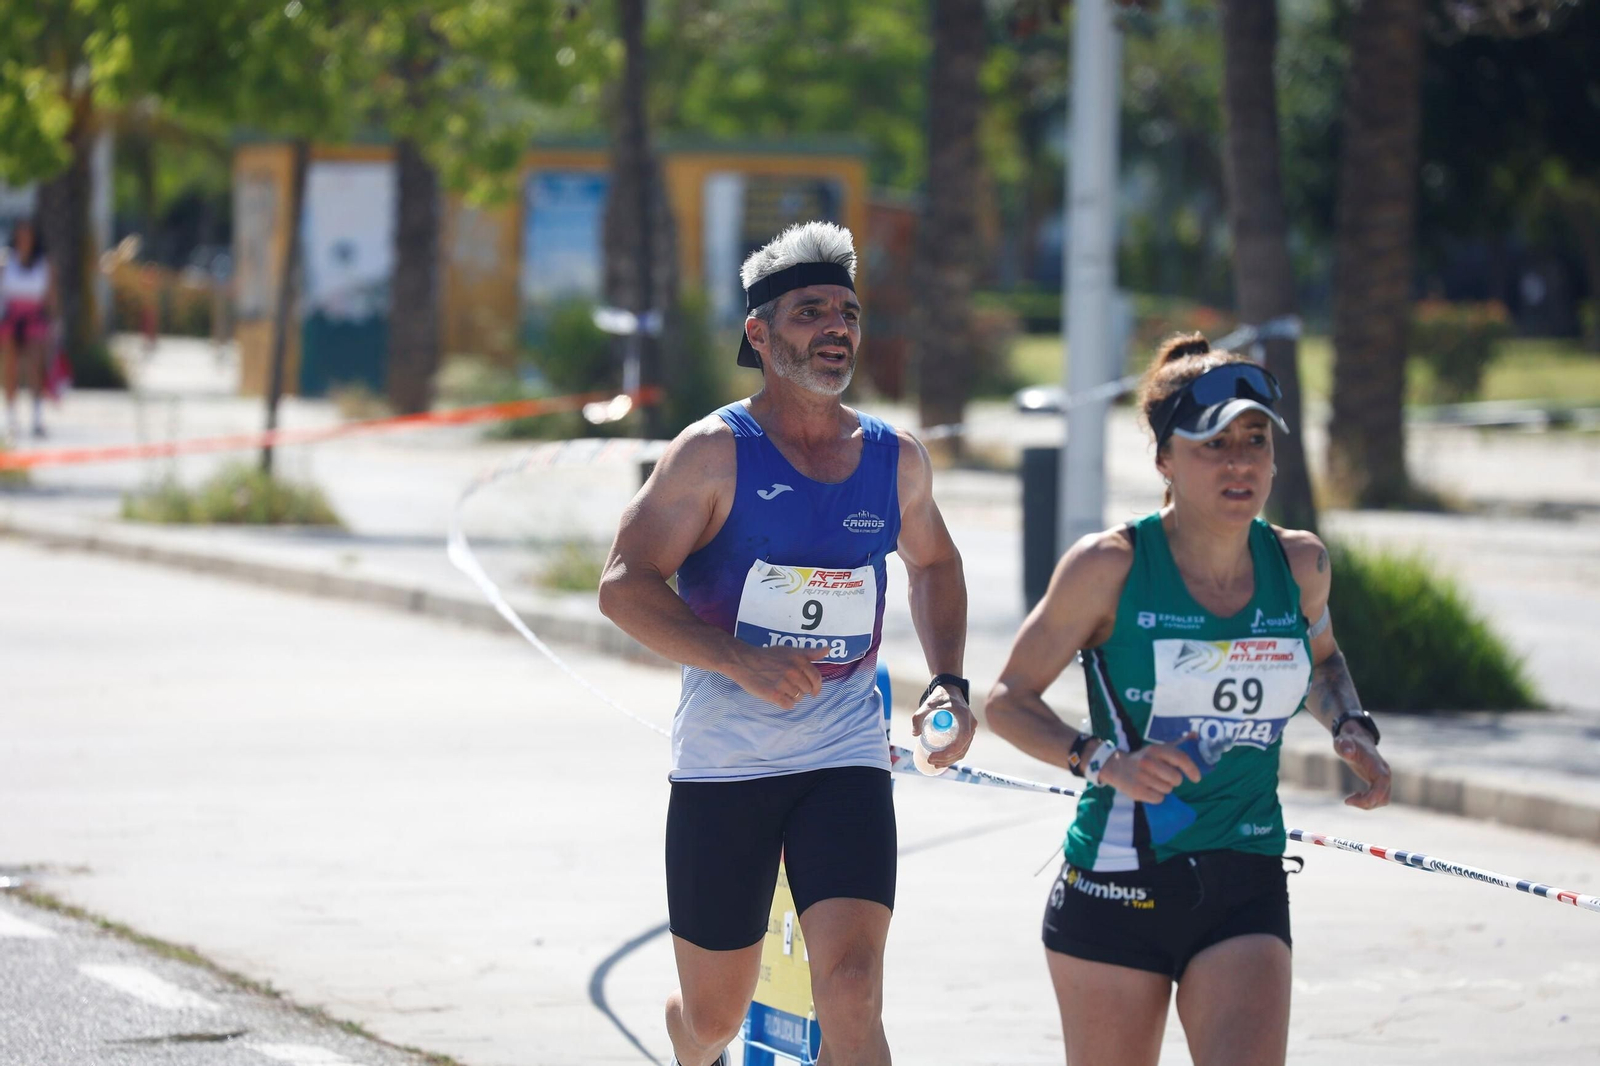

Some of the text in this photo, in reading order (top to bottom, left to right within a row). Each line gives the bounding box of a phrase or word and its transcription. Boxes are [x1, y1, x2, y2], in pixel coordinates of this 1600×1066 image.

[843, 519, 885, 528] CRONOS
[812, 570, 852, 581] RFEA
[803, 588, 830, 596] RUTA
[801, 600, 823, 630] 9
[1234, 641, 1277, 653] RFEA
[1212, 678, 1264, 715] 69
[1132, 899, 1155, 909] Trail
